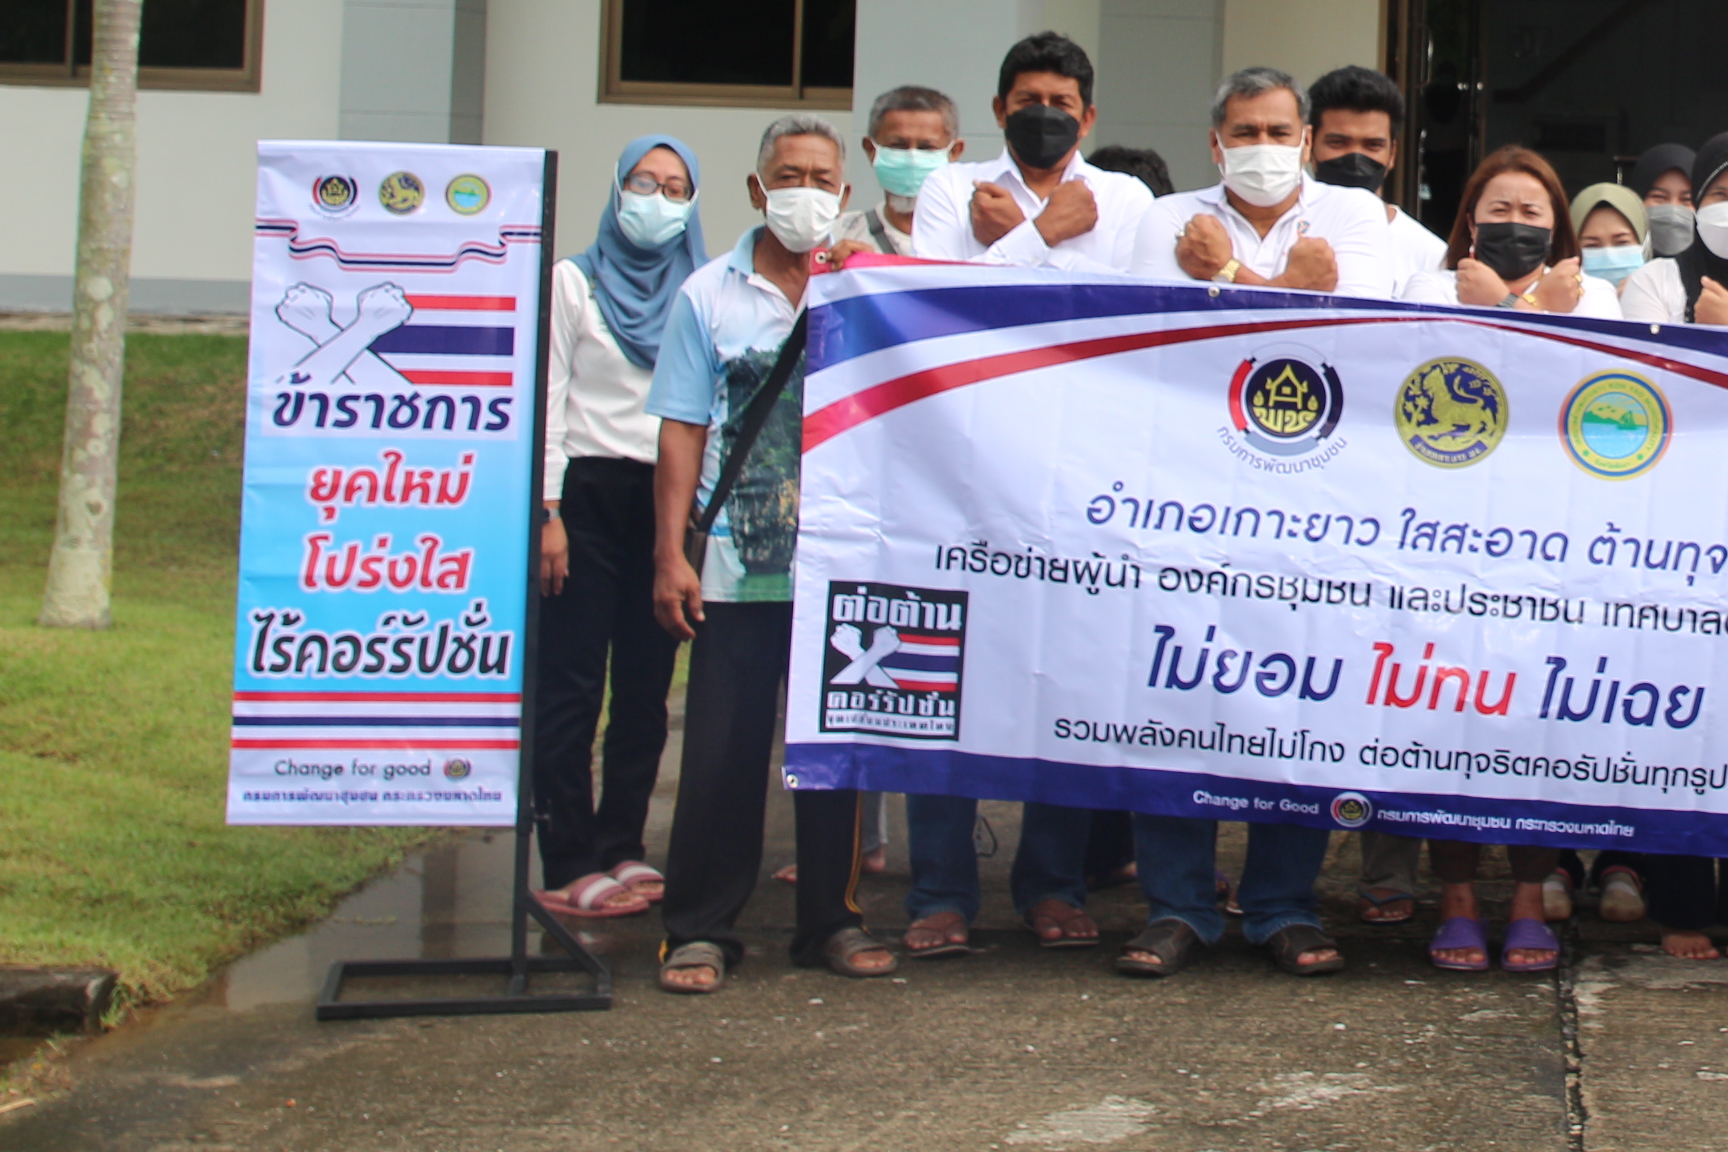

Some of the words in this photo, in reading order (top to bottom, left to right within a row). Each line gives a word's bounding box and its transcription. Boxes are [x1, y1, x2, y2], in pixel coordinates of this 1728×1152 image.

[273, 372, 513, 431] ข้าราชการ
[1217, 426, 1347, 474] กรมการพัฒนาชุมชน
[310, 450, 473, 520] ยุคใหม่
[1086, 481, 1381, 547] อำเภอเกาะยาว
[1398, 507, 1569, 563] ใสสะอาด
[304, 536, 472, 589] โปร่งใส
[936, 540, 1141, 595] เครือข่ายผู้นำ
[1158, 563, 1372, 612] องค์กรชุมชน
[1390, 583, 1585, 625] และประชาชน
[832, 586, 962, 630] ต่อต้าน
[251, 602, 510, 674] ไร้คอร์รัปชั่น
[1147, 625, 1344, 701] ไม่ยอม
[1366, 642, 1517, 715] ไม่ทน
[1539, 657, 1705, 729] ไม่เฉย
[1054, 718, 1345, 764] รวมพลังคนไทยไม่โกง
[274, 759, 343, 779] Change
[352, 759, 376, 776] for
[382, 759, 431, 779] good
[1193, 790, 1248, 809] Change
[1254, 797, 1273, 809] for
[1279, 800, 1319, 815] Good
[1377, 809, 1511, 832] กรมการพัฒนาชุมชน
[1515, 815, 1635, 838] กระทรวงมหาดไทย
